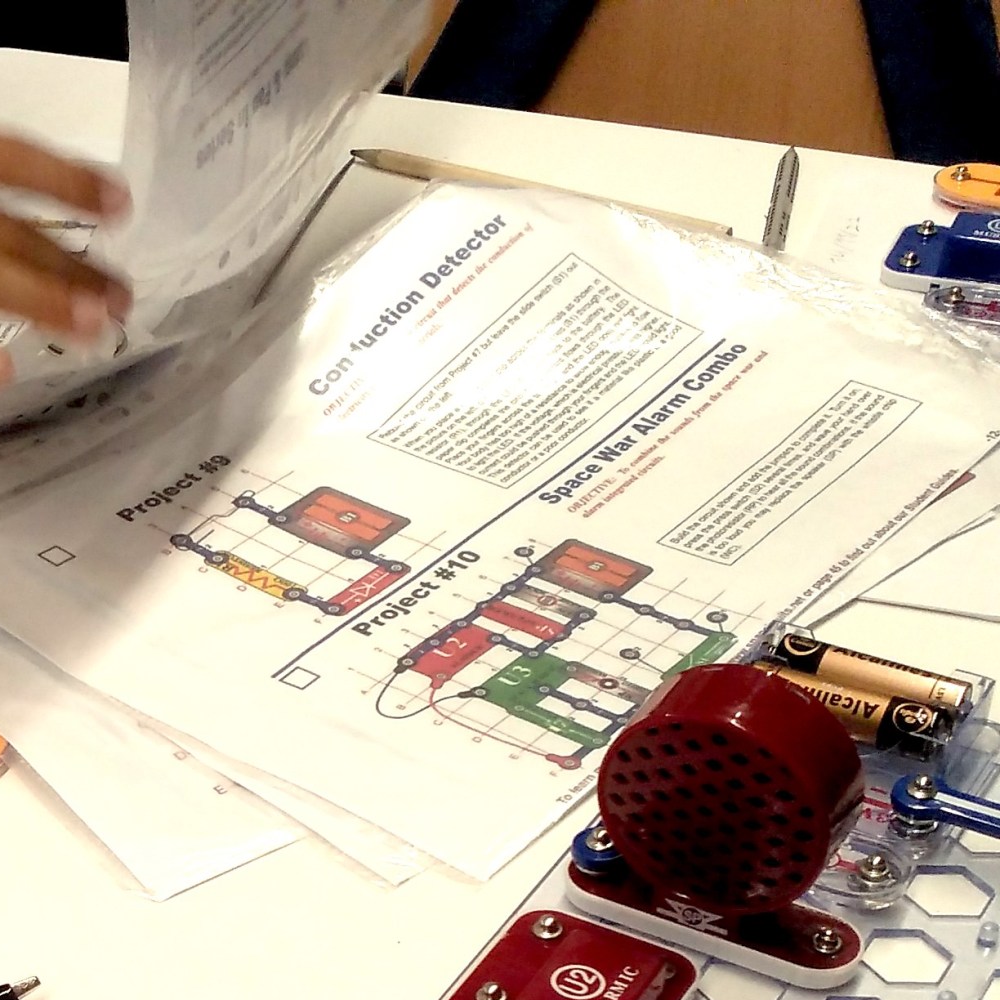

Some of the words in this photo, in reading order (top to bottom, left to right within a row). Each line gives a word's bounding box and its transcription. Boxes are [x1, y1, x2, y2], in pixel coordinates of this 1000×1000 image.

[309, 291, 423, 394] Conuction
[420, 216, 505, 288] Detector
[539, 464, 602, 504] Space
[594, 435, 636, 462] War
[632, 394, 690, 435] Alarm
[683, 345, 746, 391] Combo
[116, 471, 203, 524] Project
[199, 454, 232, 475] #9
[351, 572, 458, 638] Project
[433, 549, 481, 582] #10
[497, 665, 532, 686] U3
[558, 969, 599, 995] U2
[618, 966, 640, 983] IC
